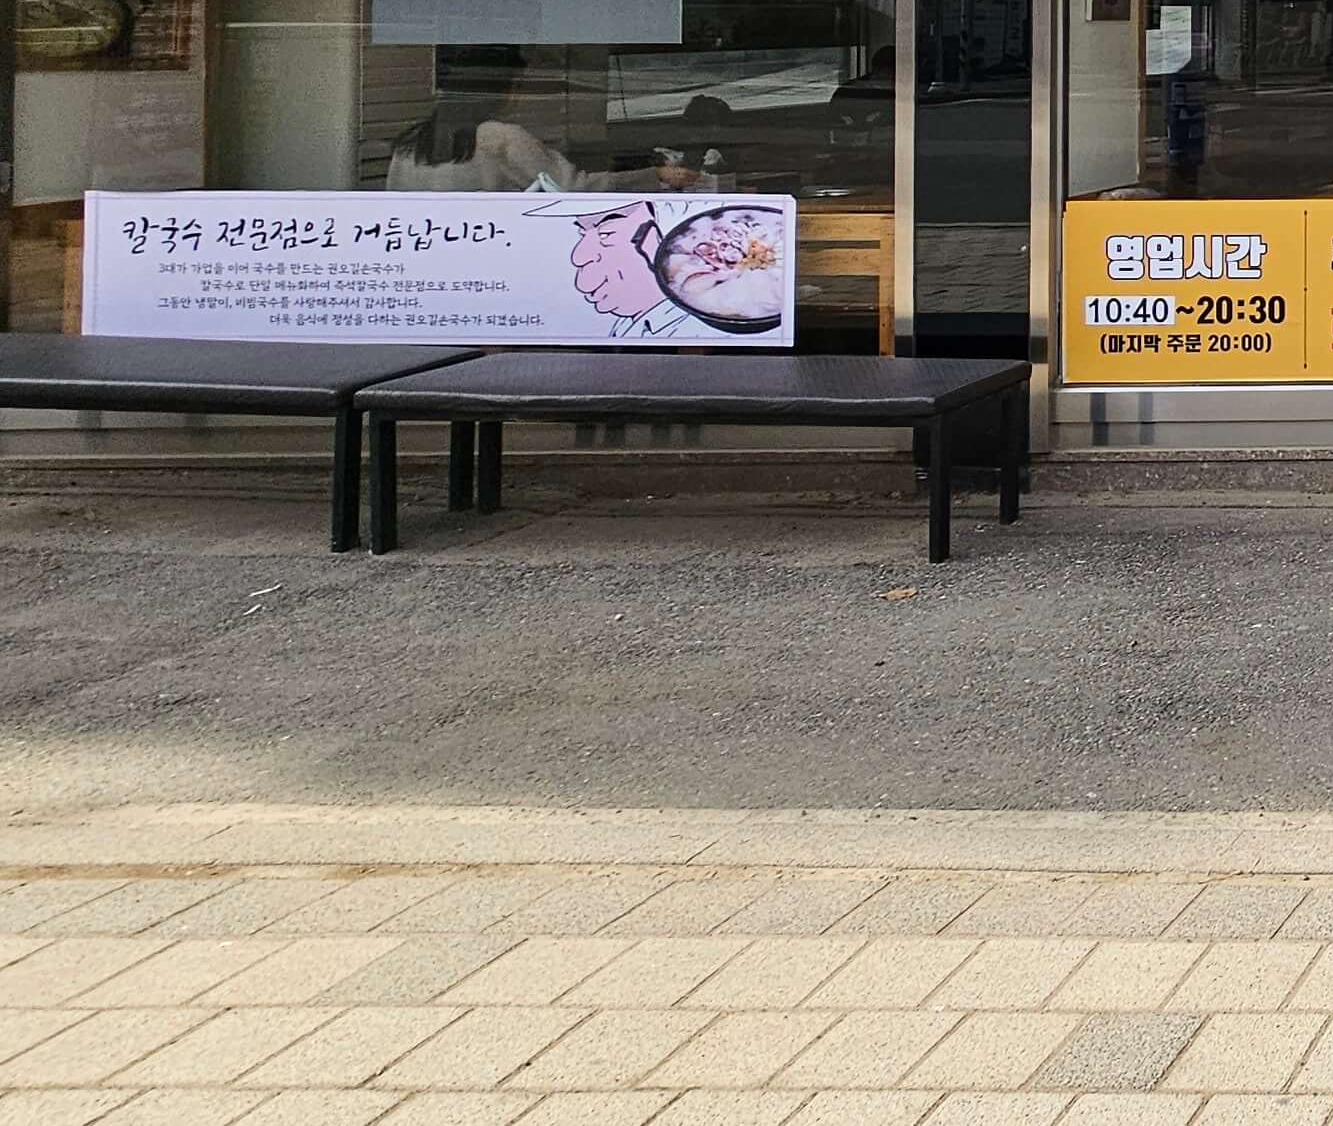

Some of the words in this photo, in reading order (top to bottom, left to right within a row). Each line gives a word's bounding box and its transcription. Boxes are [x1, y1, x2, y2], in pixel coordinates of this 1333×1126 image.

[122, 216, 203, 254] 칼국수
[216, 217, 338, 251] 전문점으로
[253, 262, 286, 275] 국수를
[1105, 234, 1268, 281] 영업시간
[1099, 333, 1162, 354] (마지막
[1167, 334, 1202, 353] 주문
[1211, 333, 1273, 354] 20:00)
